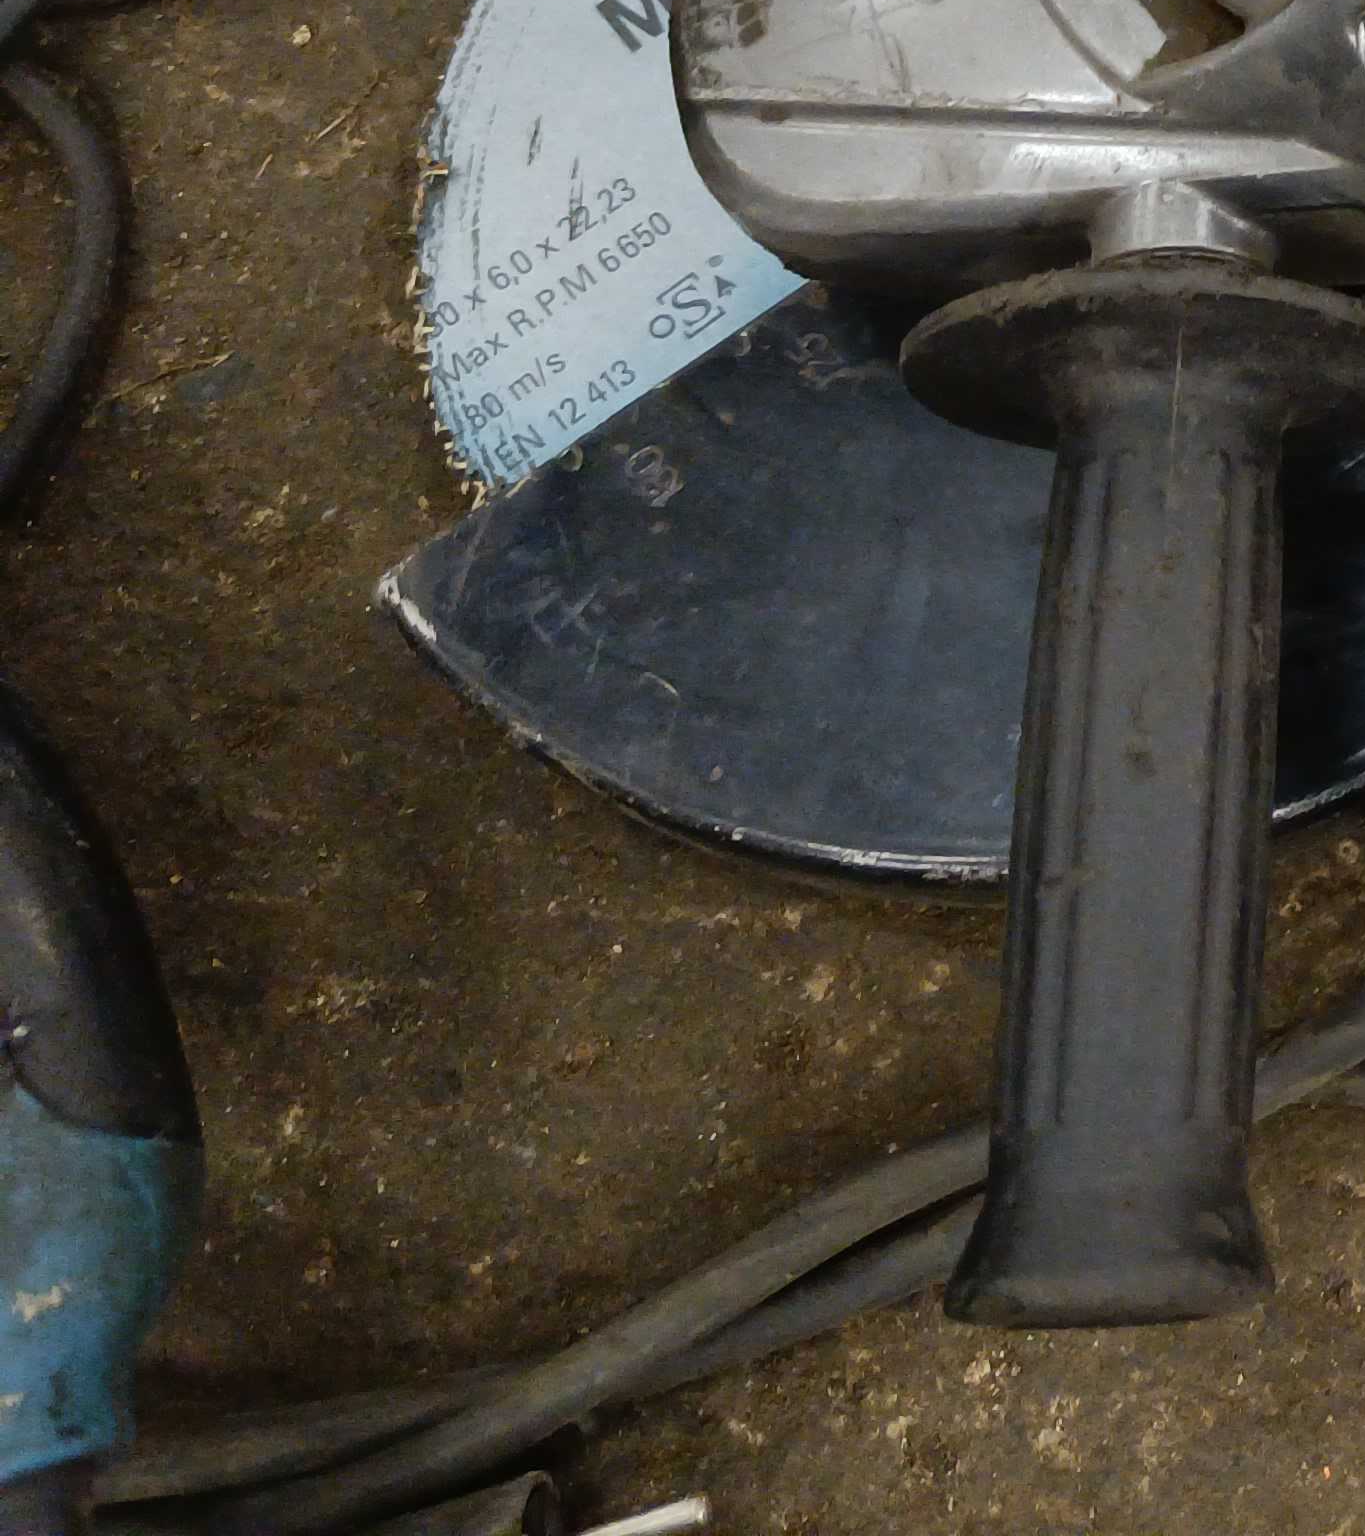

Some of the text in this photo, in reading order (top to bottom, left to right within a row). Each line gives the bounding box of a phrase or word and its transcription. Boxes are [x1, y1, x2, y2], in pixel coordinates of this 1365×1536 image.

[487, 249, 533, 290] 6,0
[536, 236, 560, 259] x
[556, 177, 636, 242] 22,23
[432, 332, 509, 391] Max
[461, 353, 567, 431] 80 m/s
[494, 424, 547, 471] EN
